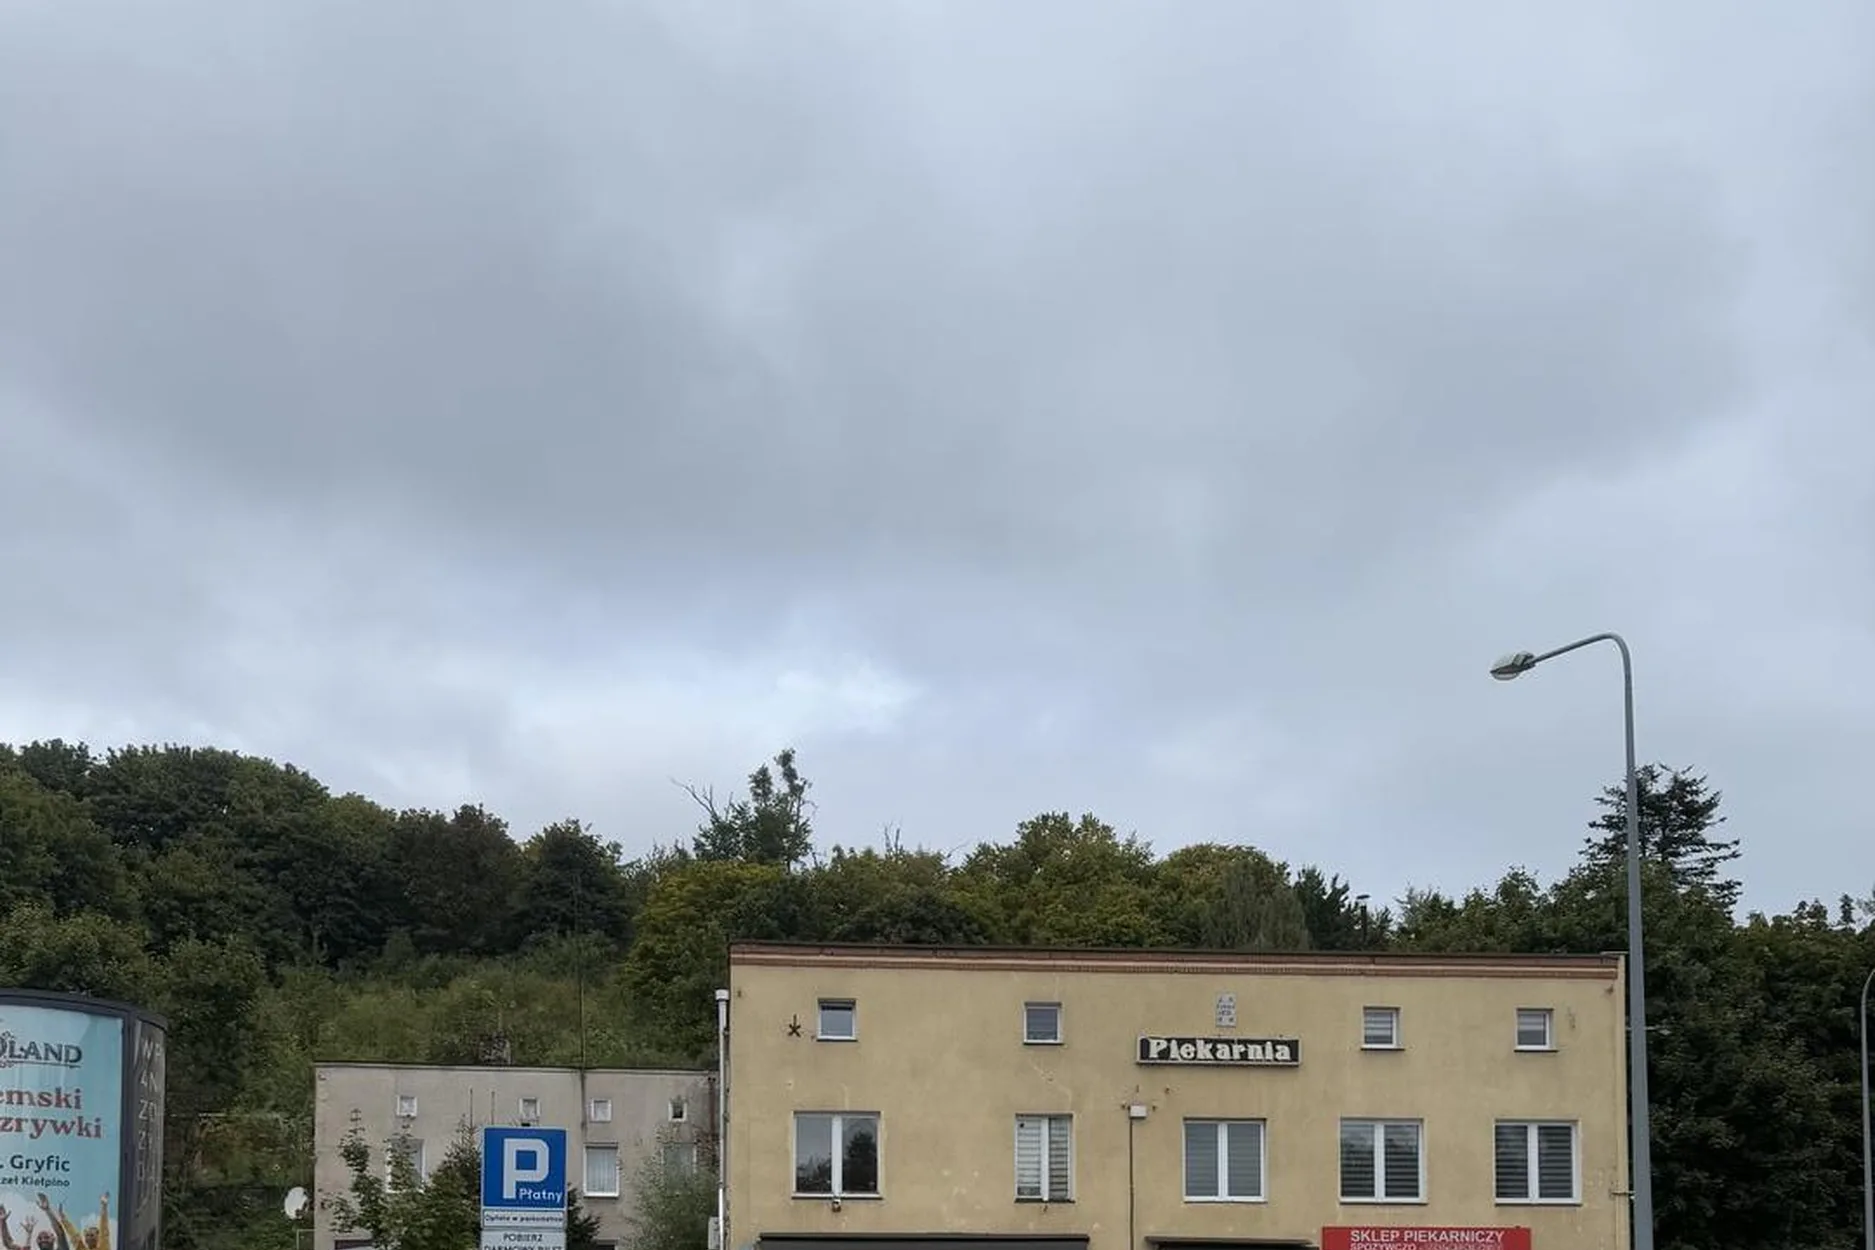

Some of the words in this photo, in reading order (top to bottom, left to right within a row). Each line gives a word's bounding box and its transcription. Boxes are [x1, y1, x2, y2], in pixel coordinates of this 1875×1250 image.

[1149, 1039, 1291, 1061] Piekarnia
[0, 1087, 82, 1109] mski
[10, 1154, 71, 1174] Gryfic
[503, 1138, 549, 1199] P
[519, 1188, 562, 1203] Płatny
[503, 1233, 543, 1242] POBIERZ
[1351, 1230, 1400, 1242] SKLEP
[1403, 1230, 1505, 1243] PIEKARNICZY
